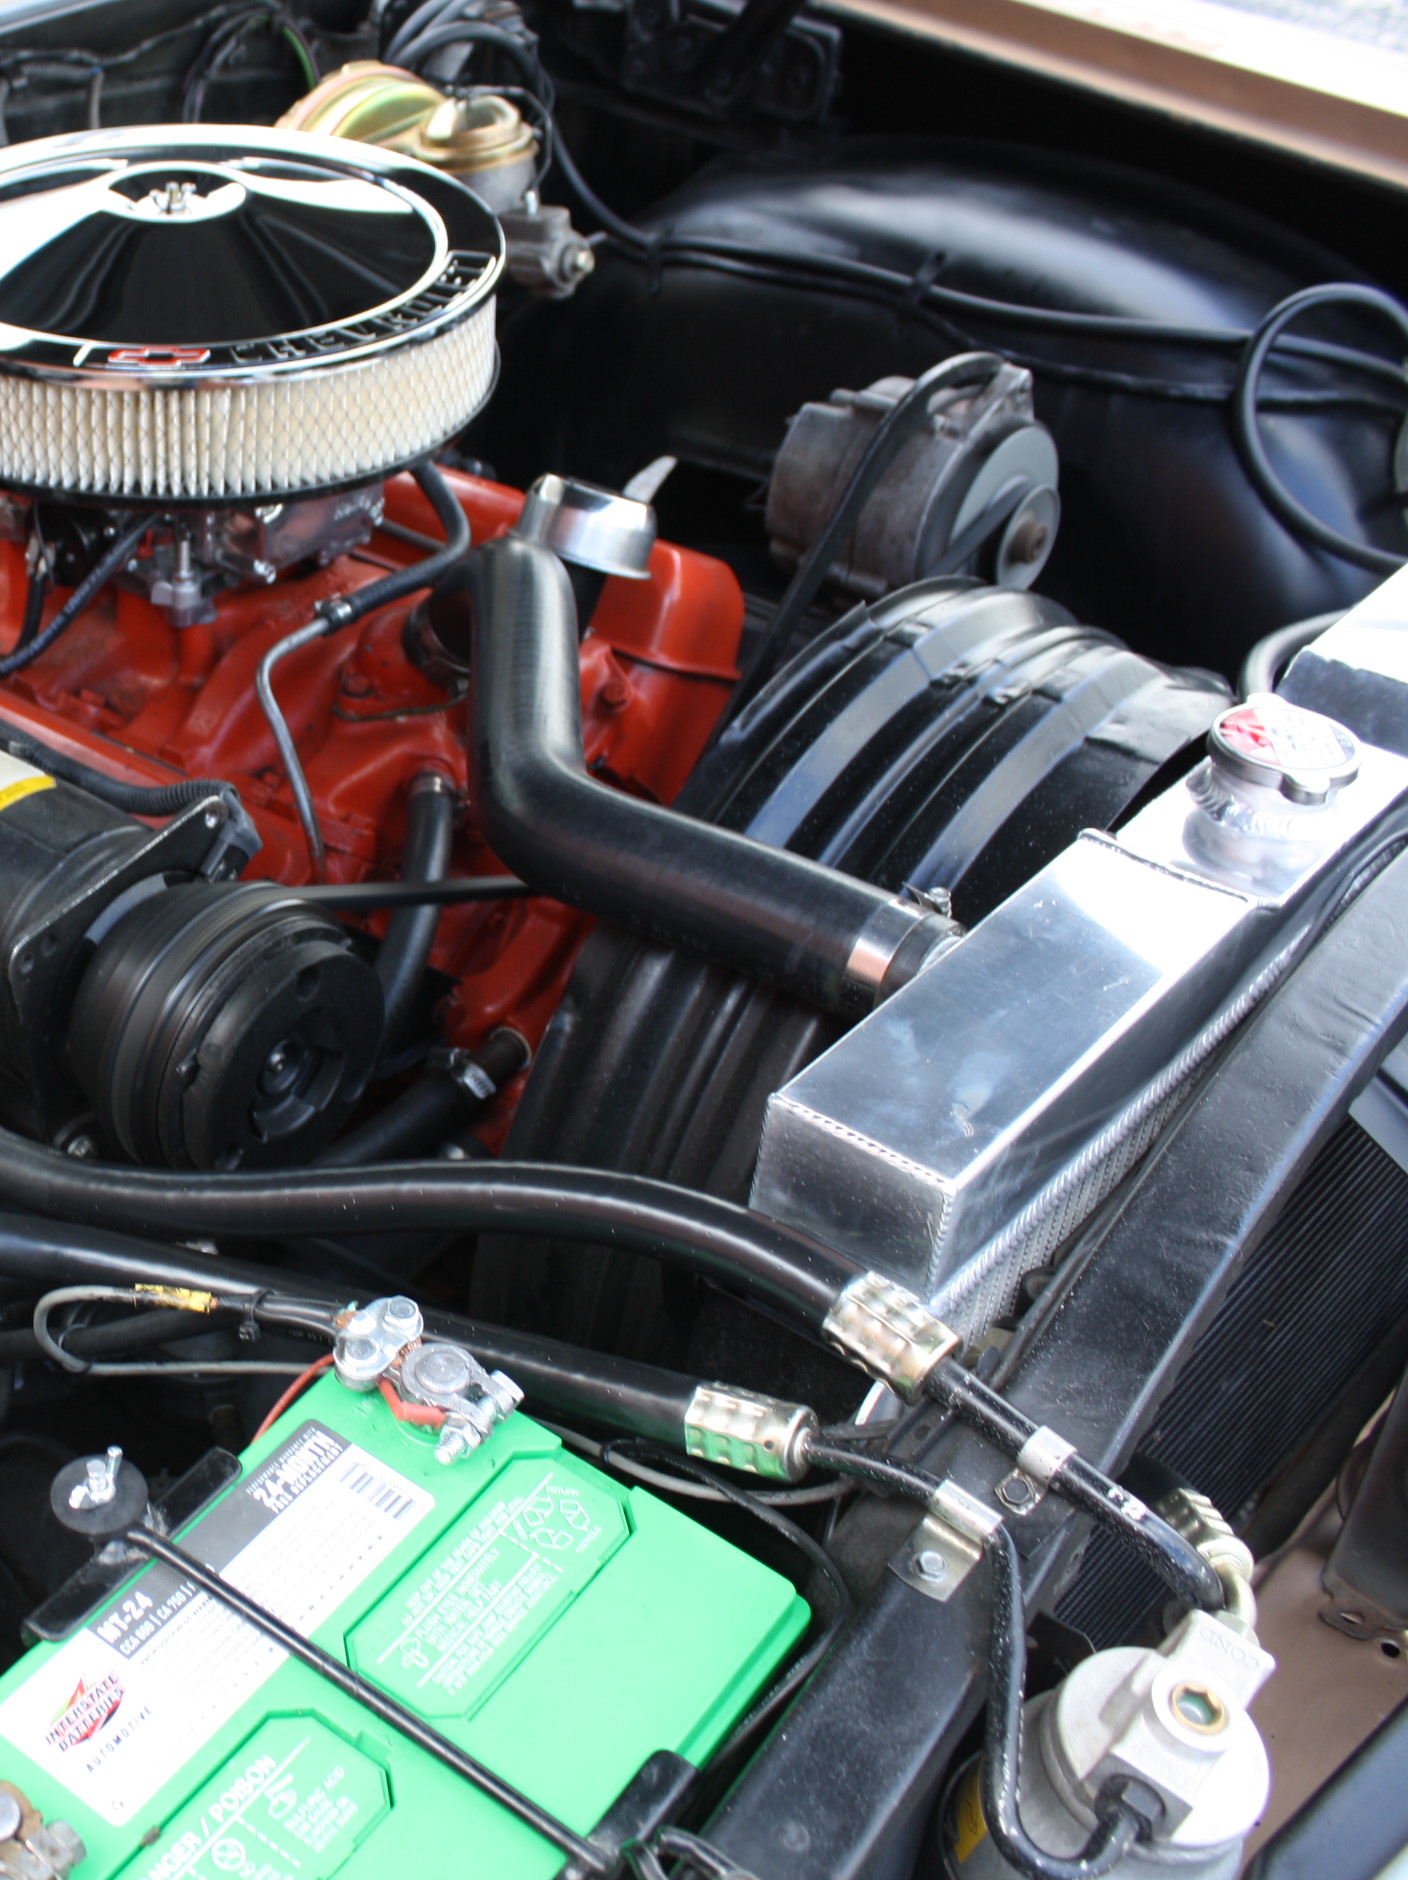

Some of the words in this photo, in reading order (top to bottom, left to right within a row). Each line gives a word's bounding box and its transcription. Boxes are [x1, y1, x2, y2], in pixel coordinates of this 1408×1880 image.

[229, 250, 497, 366] CHEVROLET
[253, 1431, 334, 1508] 24-MONTH
[97, 1592, 152, 1643] MT-24
[119, 1635, 140, 1655] CCA
[156, 1605, 173, 1620] CA
[45, 1669, 119, 1745] INTERSTATE
[58, 1684, 125, 1753] BATTERIES
[86, 1705, 152, 1773] AUTOMOTIVE
[208, 1755, 277, 1822] POISON
